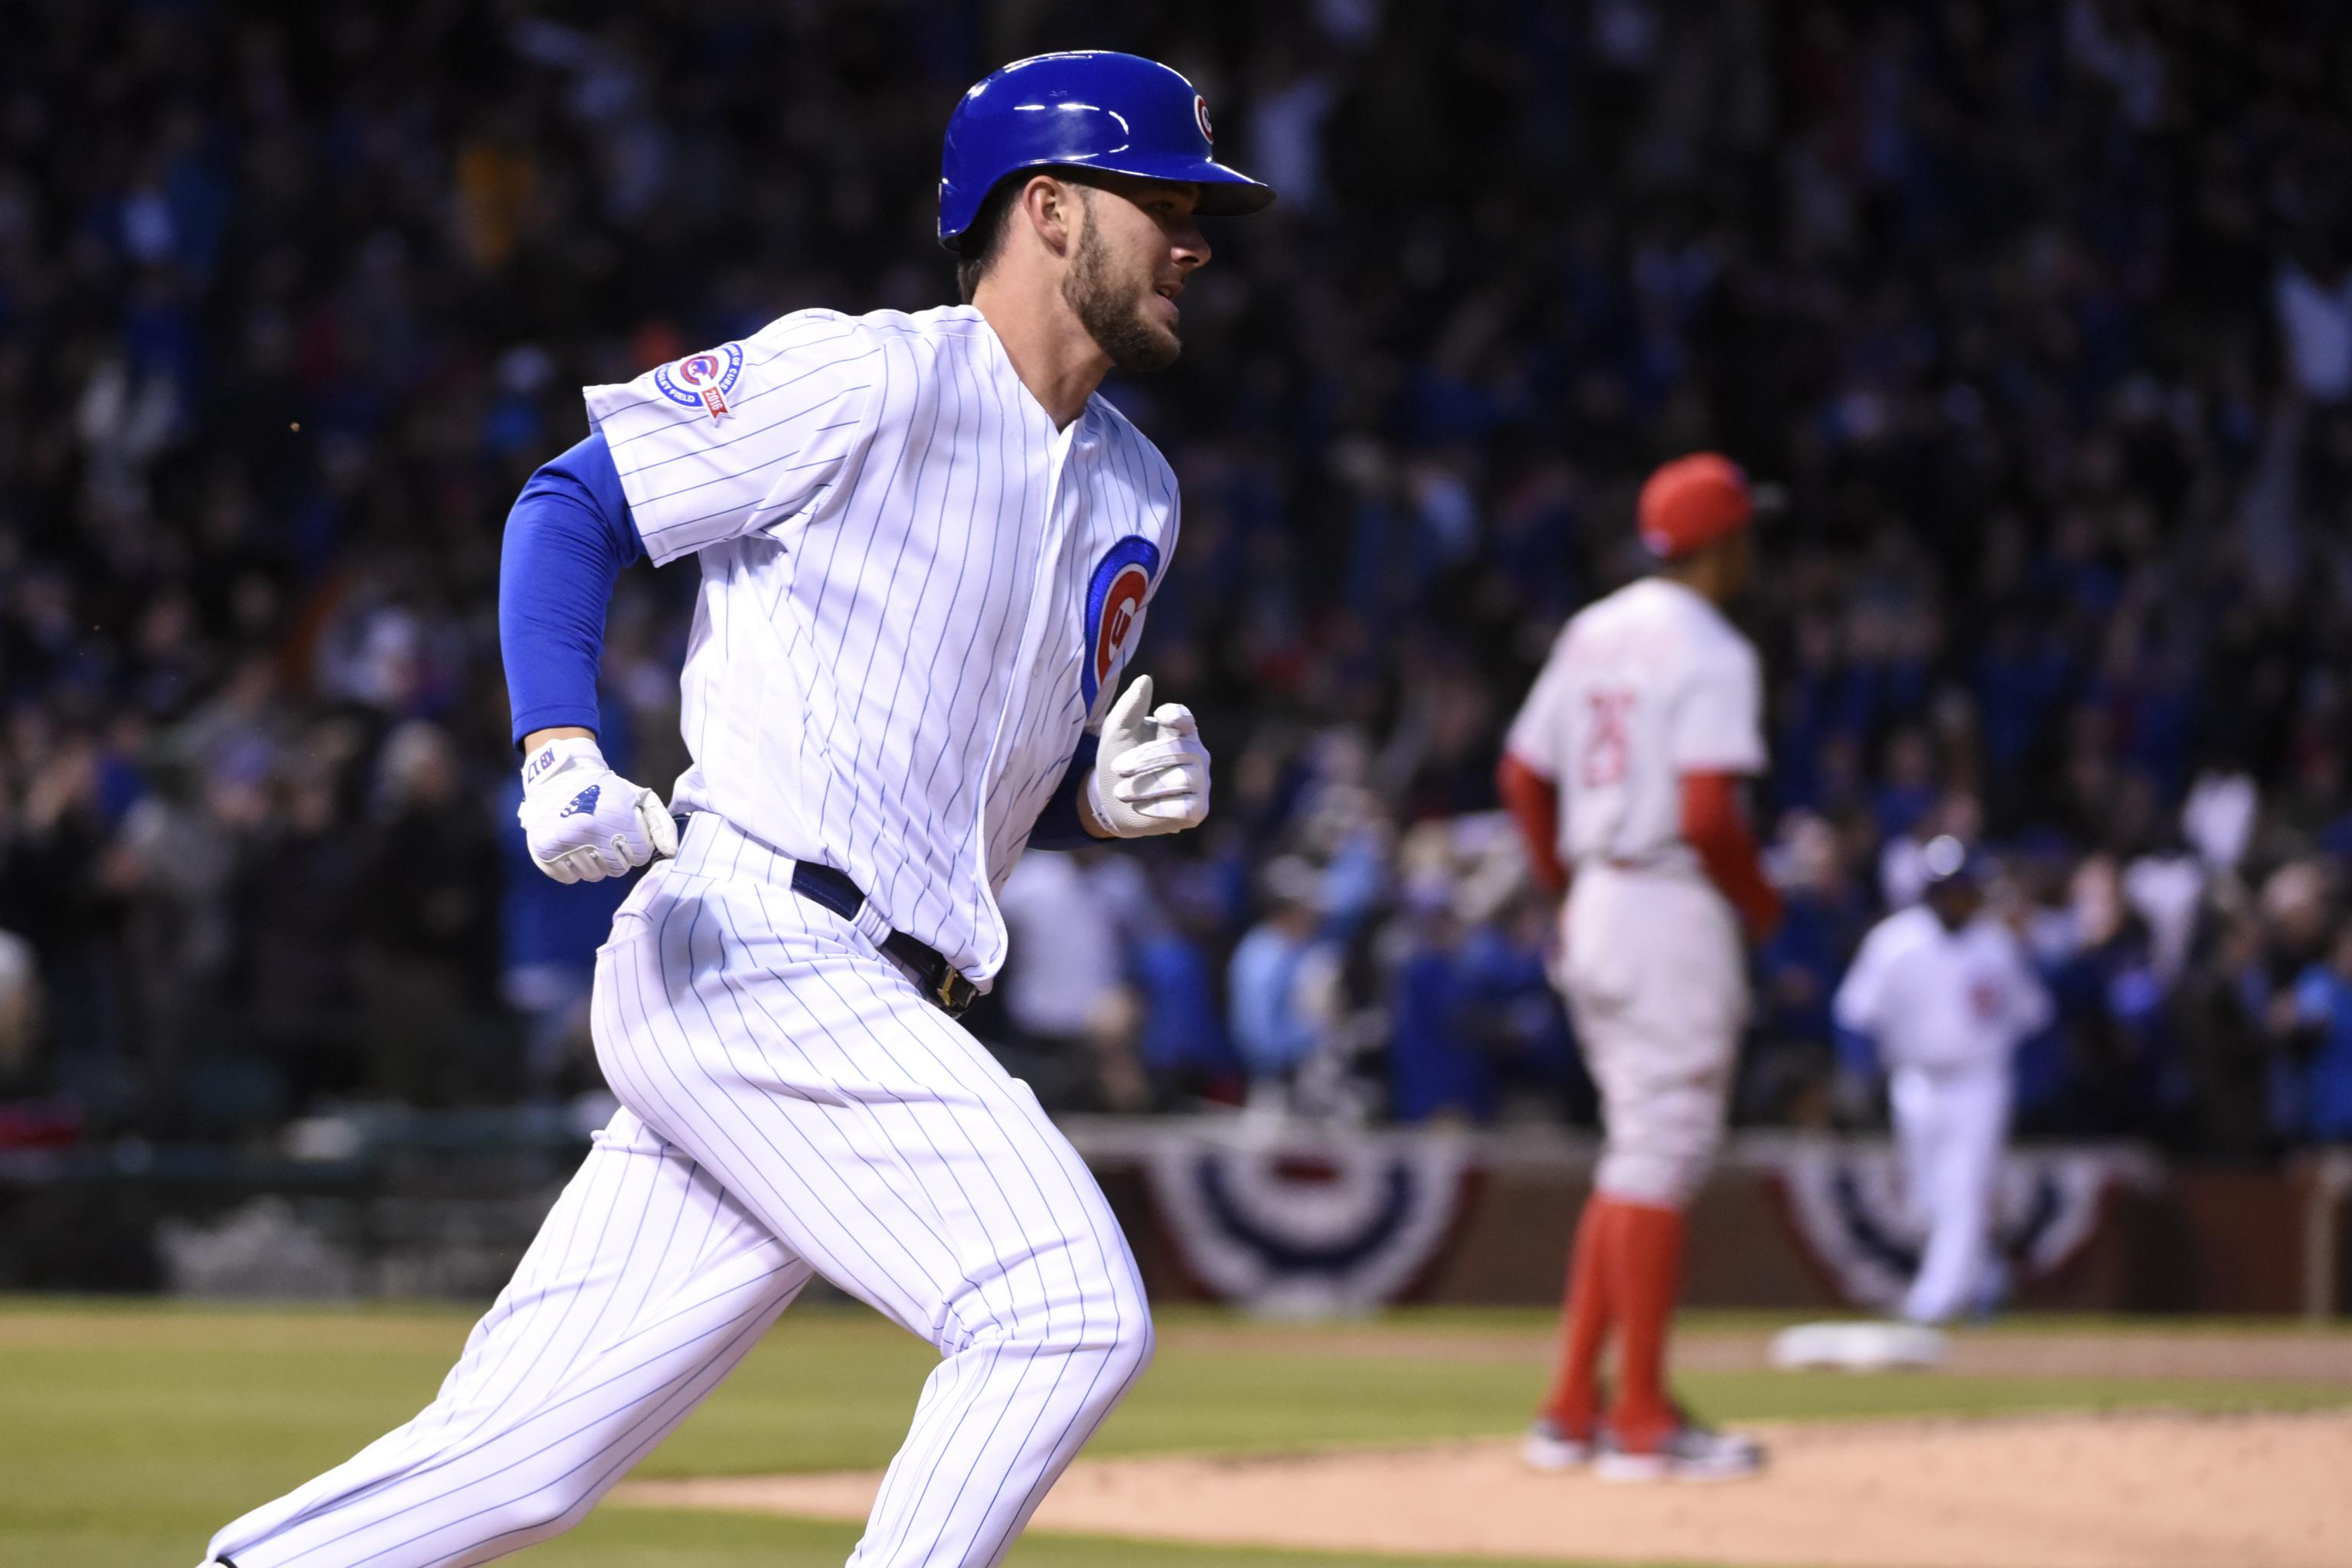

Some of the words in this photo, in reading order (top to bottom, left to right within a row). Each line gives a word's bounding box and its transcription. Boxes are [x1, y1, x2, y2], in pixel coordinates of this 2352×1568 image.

[670, 390, 695, 403] FIELD
[705, 390, 724, 411] 2016
[528, 760, 541, 783] 17
